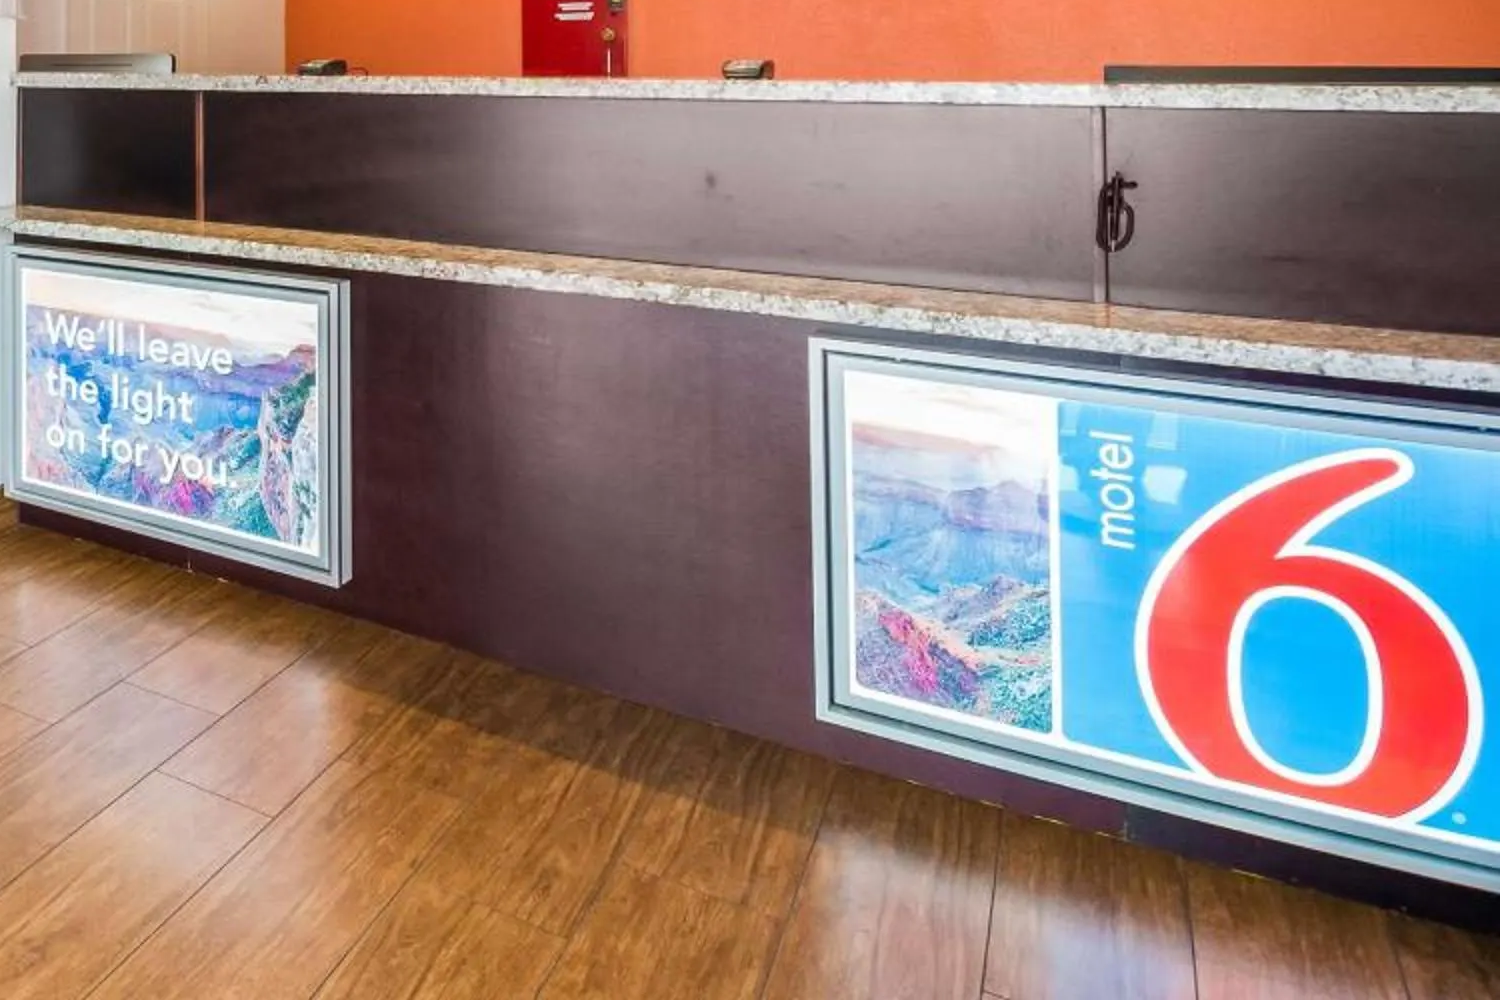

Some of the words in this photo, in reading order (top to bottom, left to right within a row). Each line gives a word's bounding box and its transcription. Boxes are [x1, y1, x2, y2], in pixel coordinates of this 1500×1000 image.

[45, 311, 125, 357] We'll
[139, 323, 234, 375] leave
[46, 364, 99, 405] the
[112, 374, 193, 425] light
[45, 424, 85, 455] on
[99, 425, 149, 467] for
[157, 448, 237, 487] you.
[1089, 429, 1136, 551] motel
[1134, 446, 1484, 826] 6
